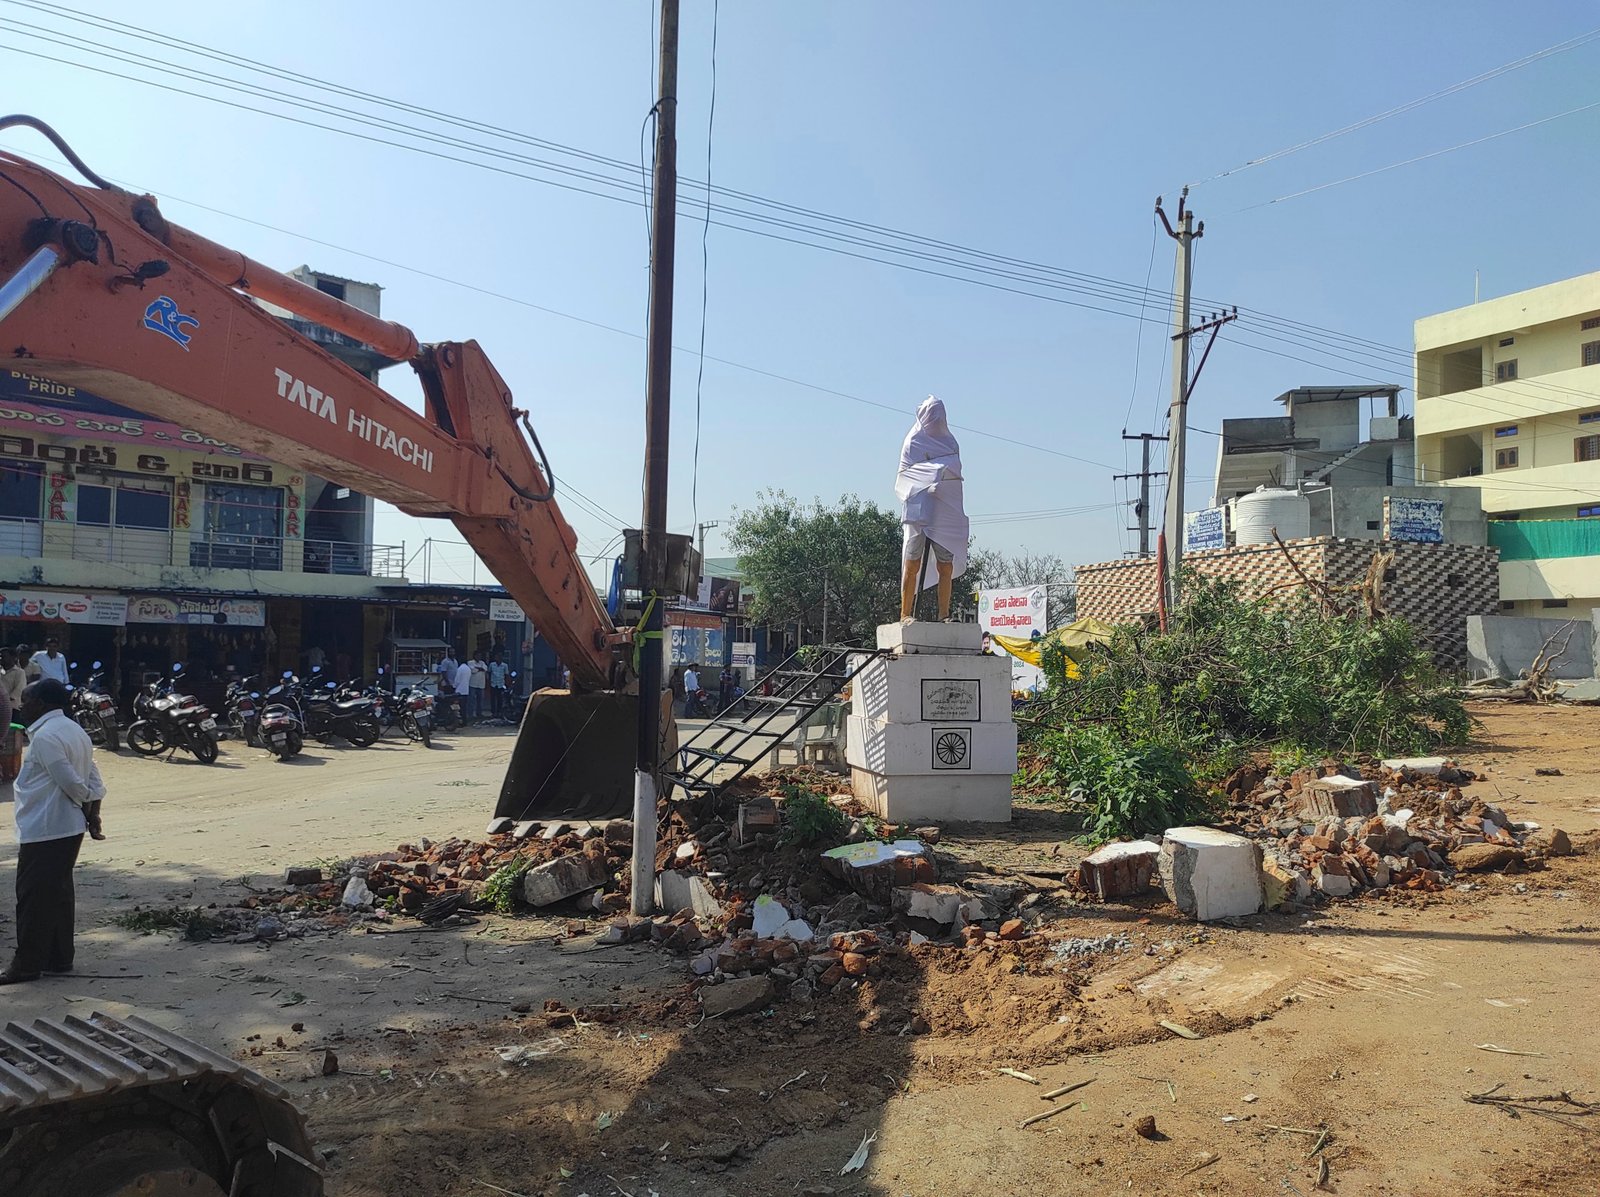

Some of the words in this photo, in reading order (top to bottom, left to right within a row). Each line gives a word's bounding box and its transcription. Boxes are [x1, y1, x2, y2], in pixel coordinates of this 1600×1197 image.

[29, 381, 76, 397] PRIDE
[274, 367, 338, 425] TATA
[347, 407, 434, 473] HITACHI
[49, 471, 68, 520] BAR
[175, 482, 191, 528] BAR
[286, 495, 301, 537] BAR
